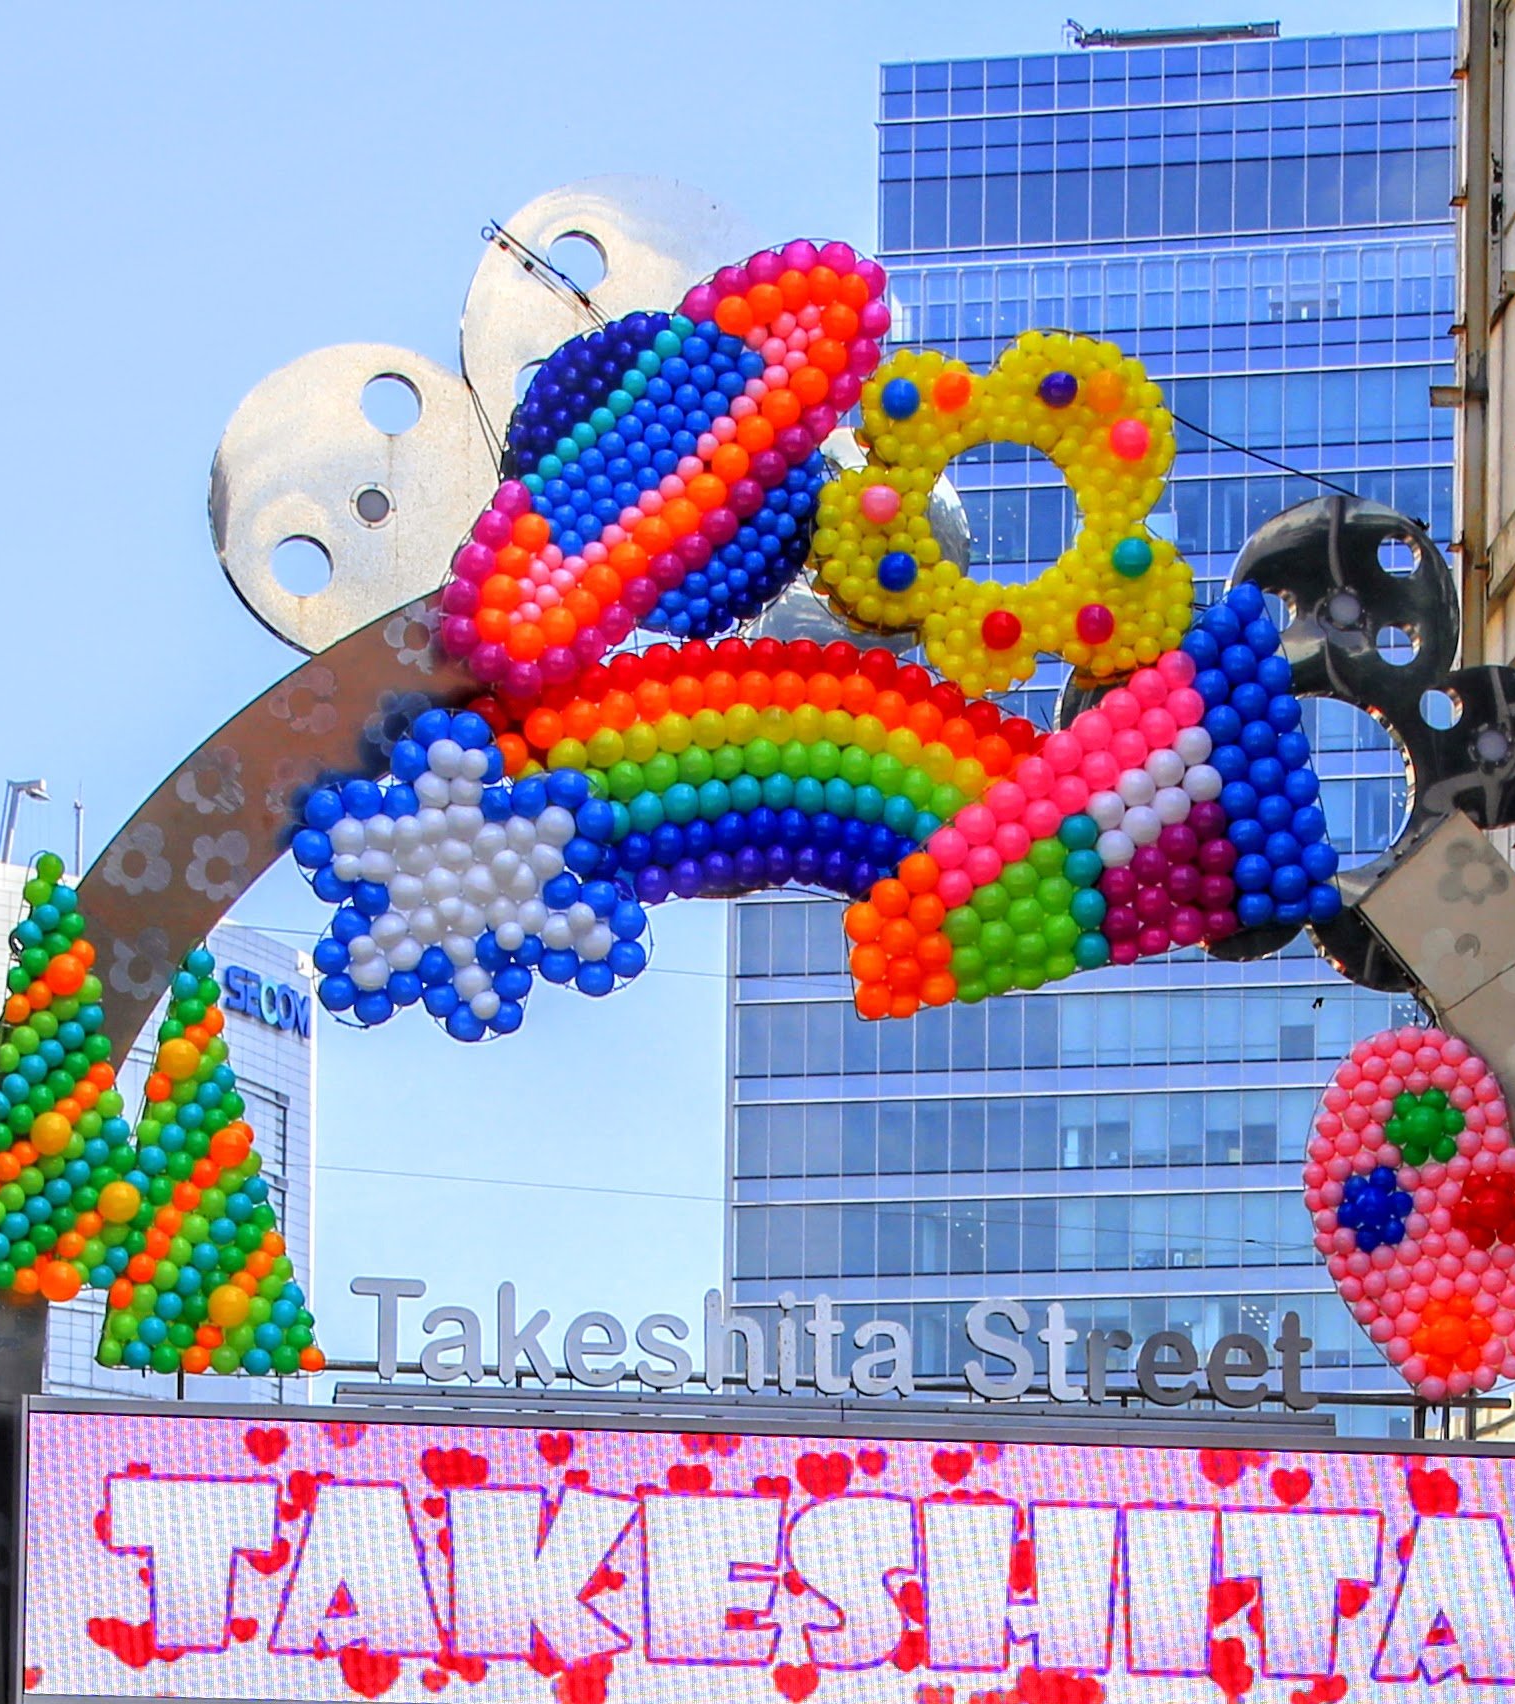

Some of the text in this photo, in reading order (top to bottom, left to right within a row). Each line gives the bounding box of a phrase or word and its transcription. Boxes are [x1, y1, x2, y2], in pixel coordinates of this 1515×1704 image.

[224, 965, 311, 1039] SECOM
[350, 1276, 1321, 1412] Takeshita Street
